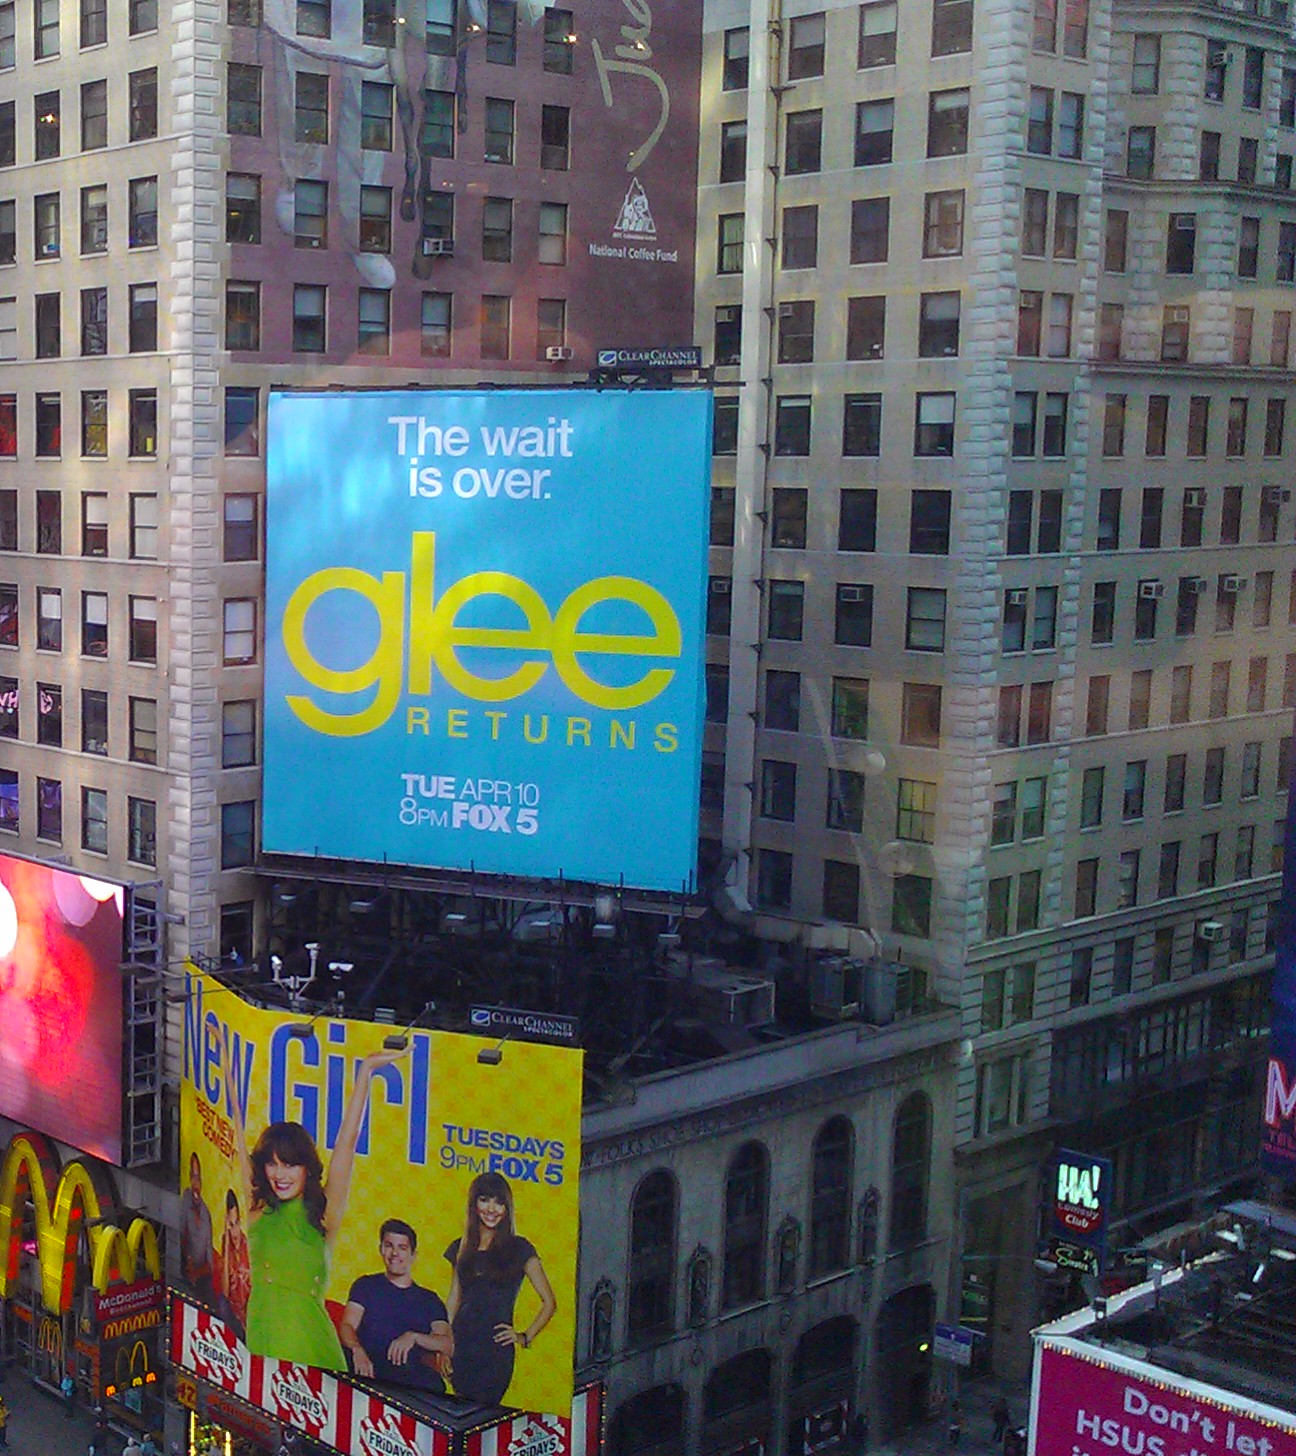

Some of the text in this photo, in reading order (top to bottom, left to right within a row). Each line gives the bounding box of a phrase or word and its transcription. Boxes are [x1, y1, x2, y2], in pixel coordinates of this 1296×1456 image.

[589, 243, 678, 262] National Coffee Fund
[389, 416, 573, 458] The wait
[409, 459, 552, 500] is over.
[282, 530, 682, 737] glee
[407, 707, 679, 753] RETURNS
[402, 773, 540, 805] TUE APR 10
[399, 797, 540, 836] 8PM FOX 5
[182, 970, 431, 1166] New Girl
[442, 1124, 565, 1161] TUESDAYS
[440, 1145, 565, 1186] 9PM FOX 5
[1058, 1163, 1101, 1210] HA!
[1065, 1214, 1089, 1229] Club
[98, 1285, 162, 1311] McDonald's
[1076, 1408, 1165, 1456] HSUS
[1124, 1386, 1274, 1456] Don't let
